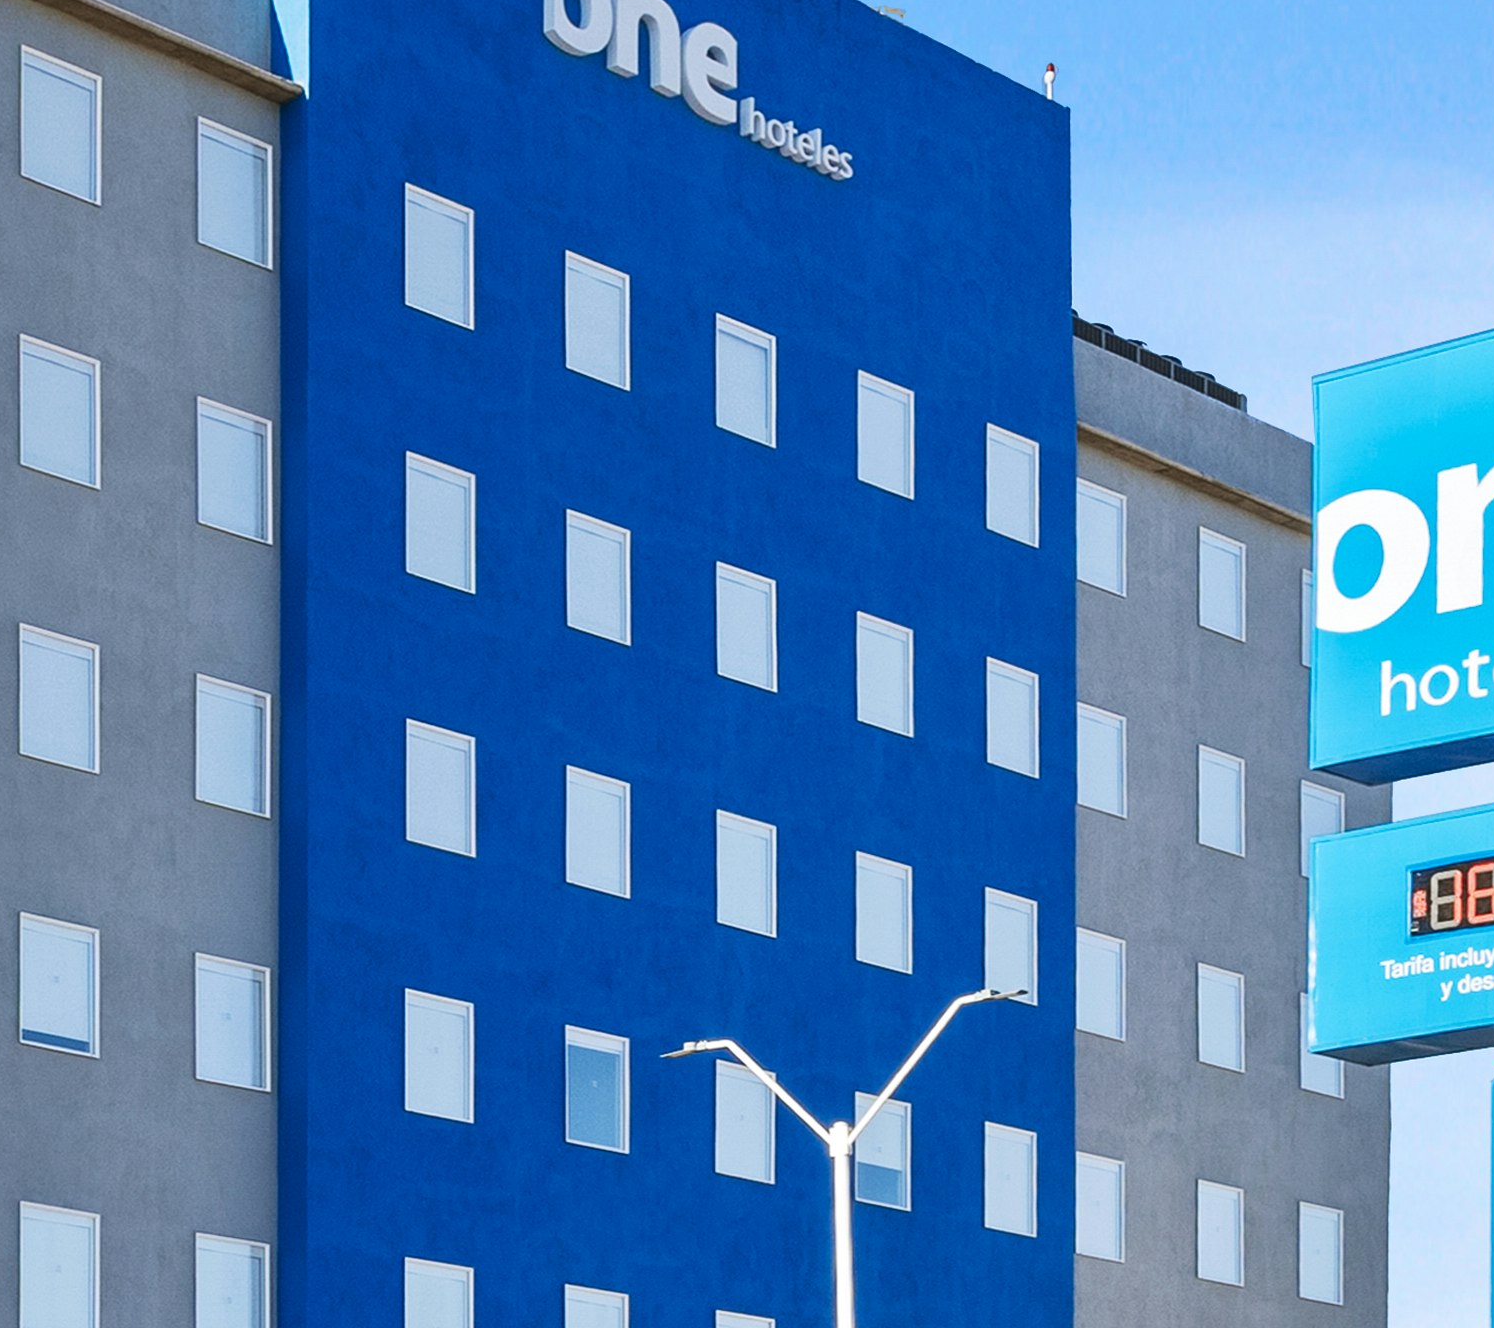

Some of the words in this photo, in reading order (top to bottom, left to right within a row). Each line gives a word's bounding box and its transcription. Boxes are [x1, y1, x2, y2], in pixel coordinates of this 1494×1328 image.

[740, 96, 854, 181] hoteles
[1380, 955, 1435, 980] Tarifa
[1440, 980, 1453, 1002] y
